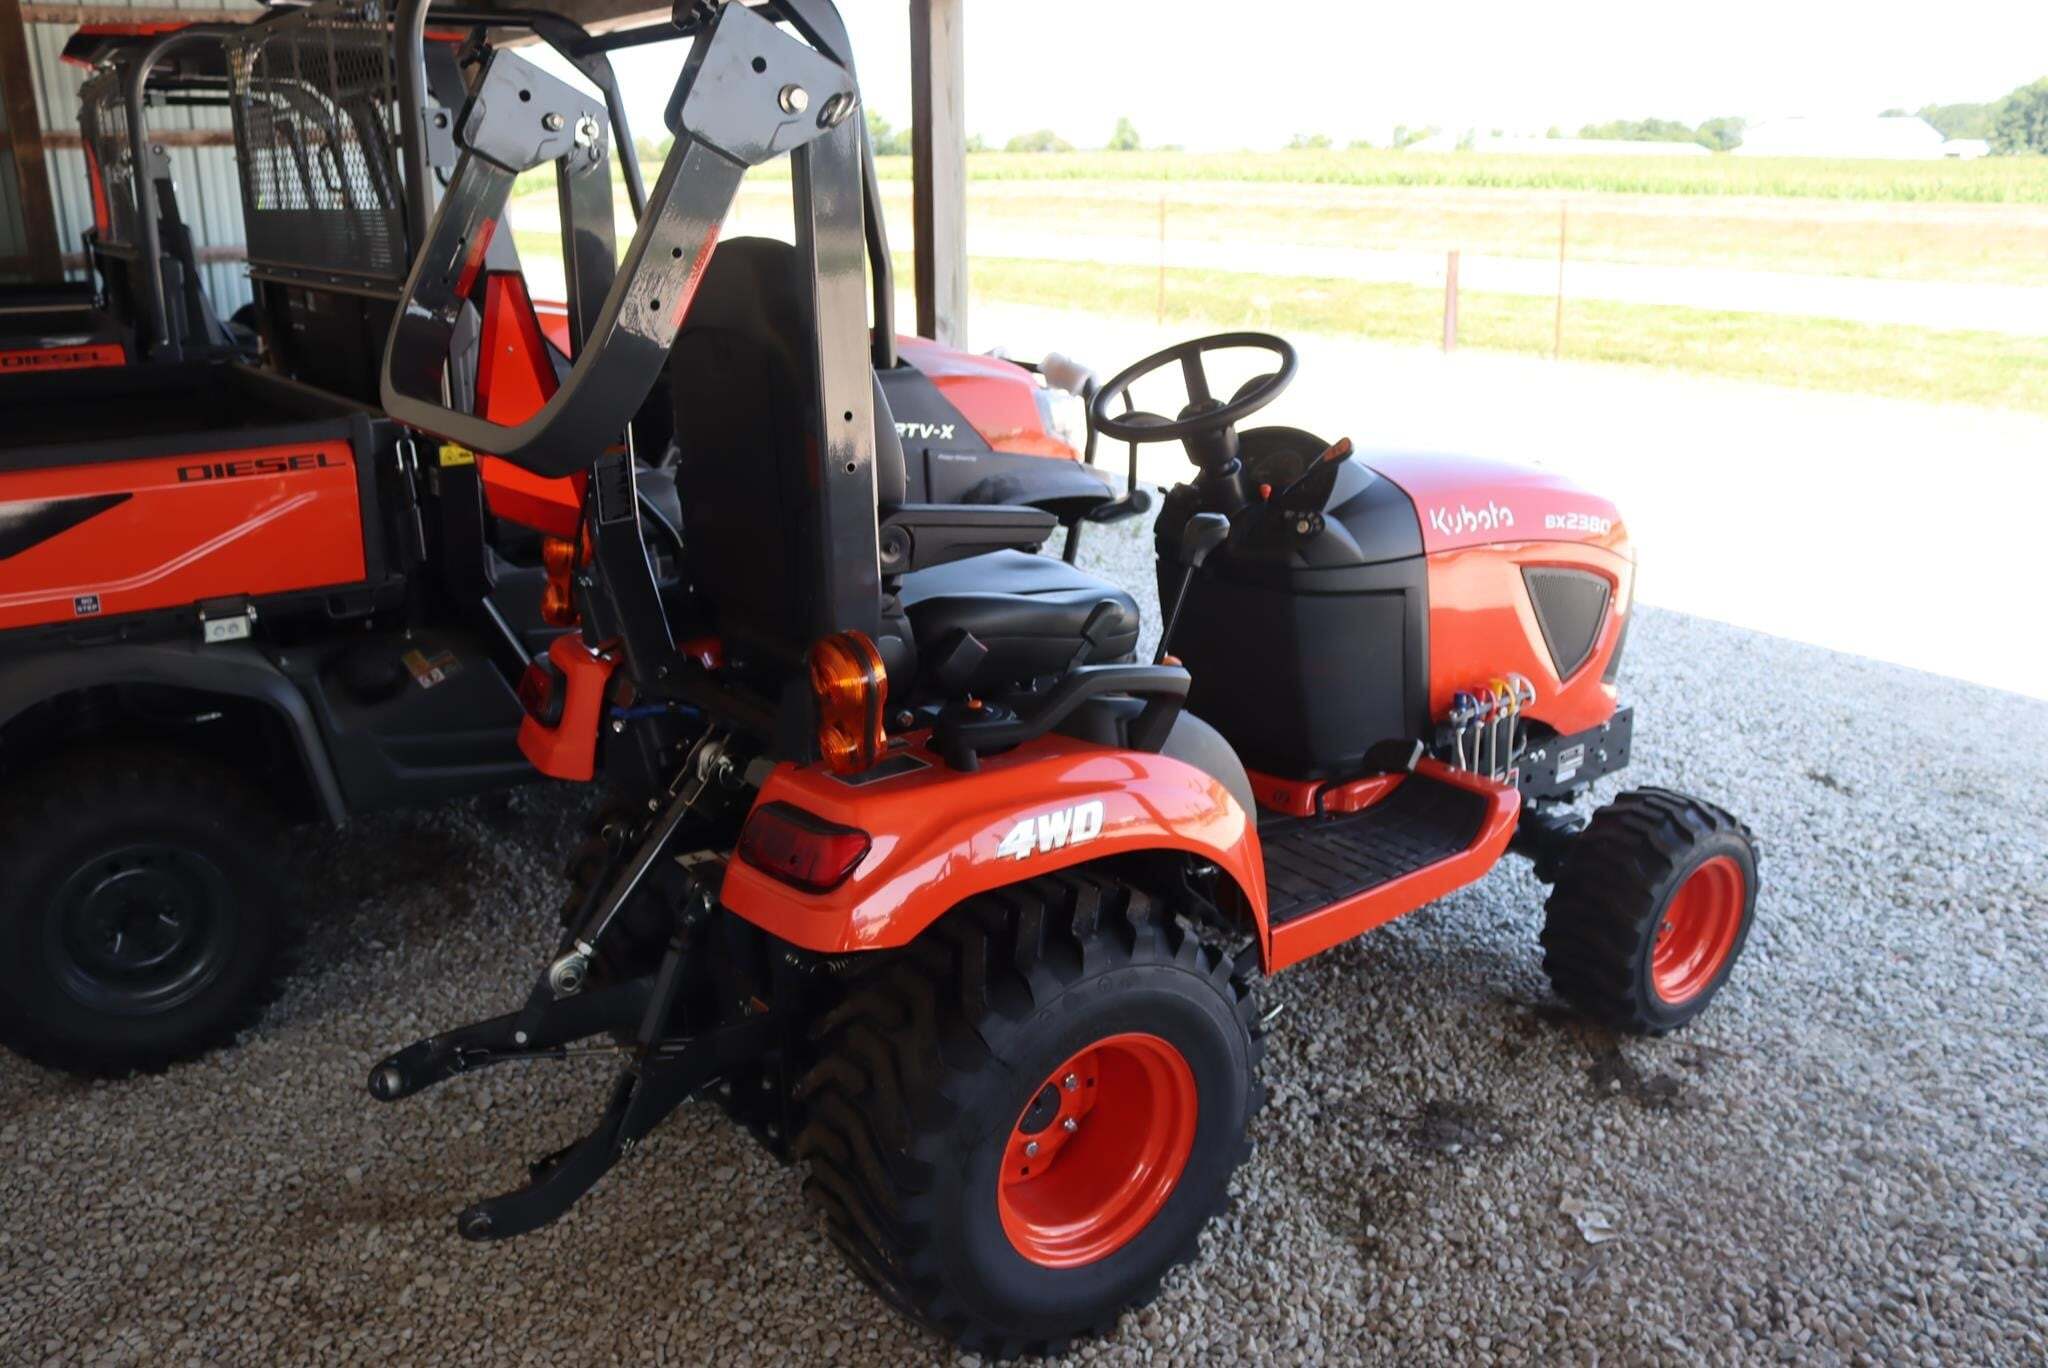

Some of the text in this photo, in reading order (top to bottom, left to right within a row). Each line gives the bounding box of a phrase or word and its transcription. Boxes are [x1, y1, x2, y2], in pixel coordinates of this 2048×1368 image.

[0, 352, 109, 367] DIESEL
[177, 453, 346, 482] DIESEL
[1430, 501, 1514, 536] Kubota
[1545, 512, 1611, 533] BX2380
[995, 800, 1104, 860] 4WD
